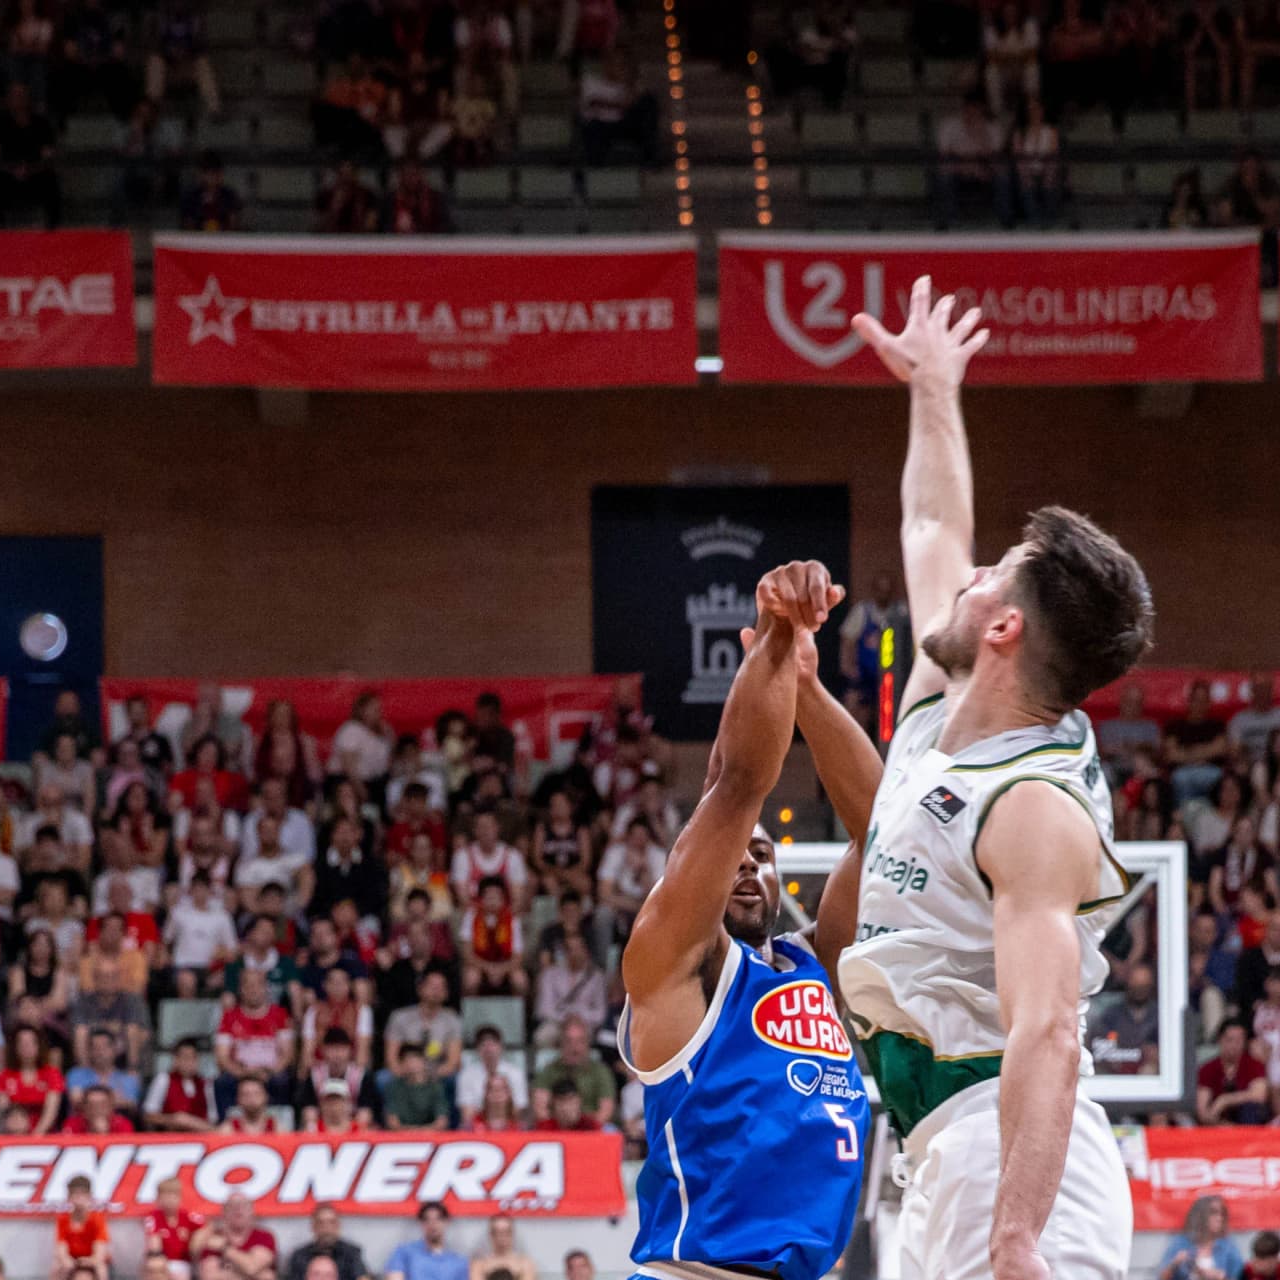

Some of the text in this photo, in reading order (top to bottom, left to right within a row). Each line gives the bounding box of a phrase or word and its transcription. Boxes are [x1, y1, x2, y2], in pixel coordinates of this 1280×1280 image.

[250, 299, 456, 335] ESTRELLA
[491, 297, 675, 335] LEVANTE
[823, 1103, 859, 1162] 5
